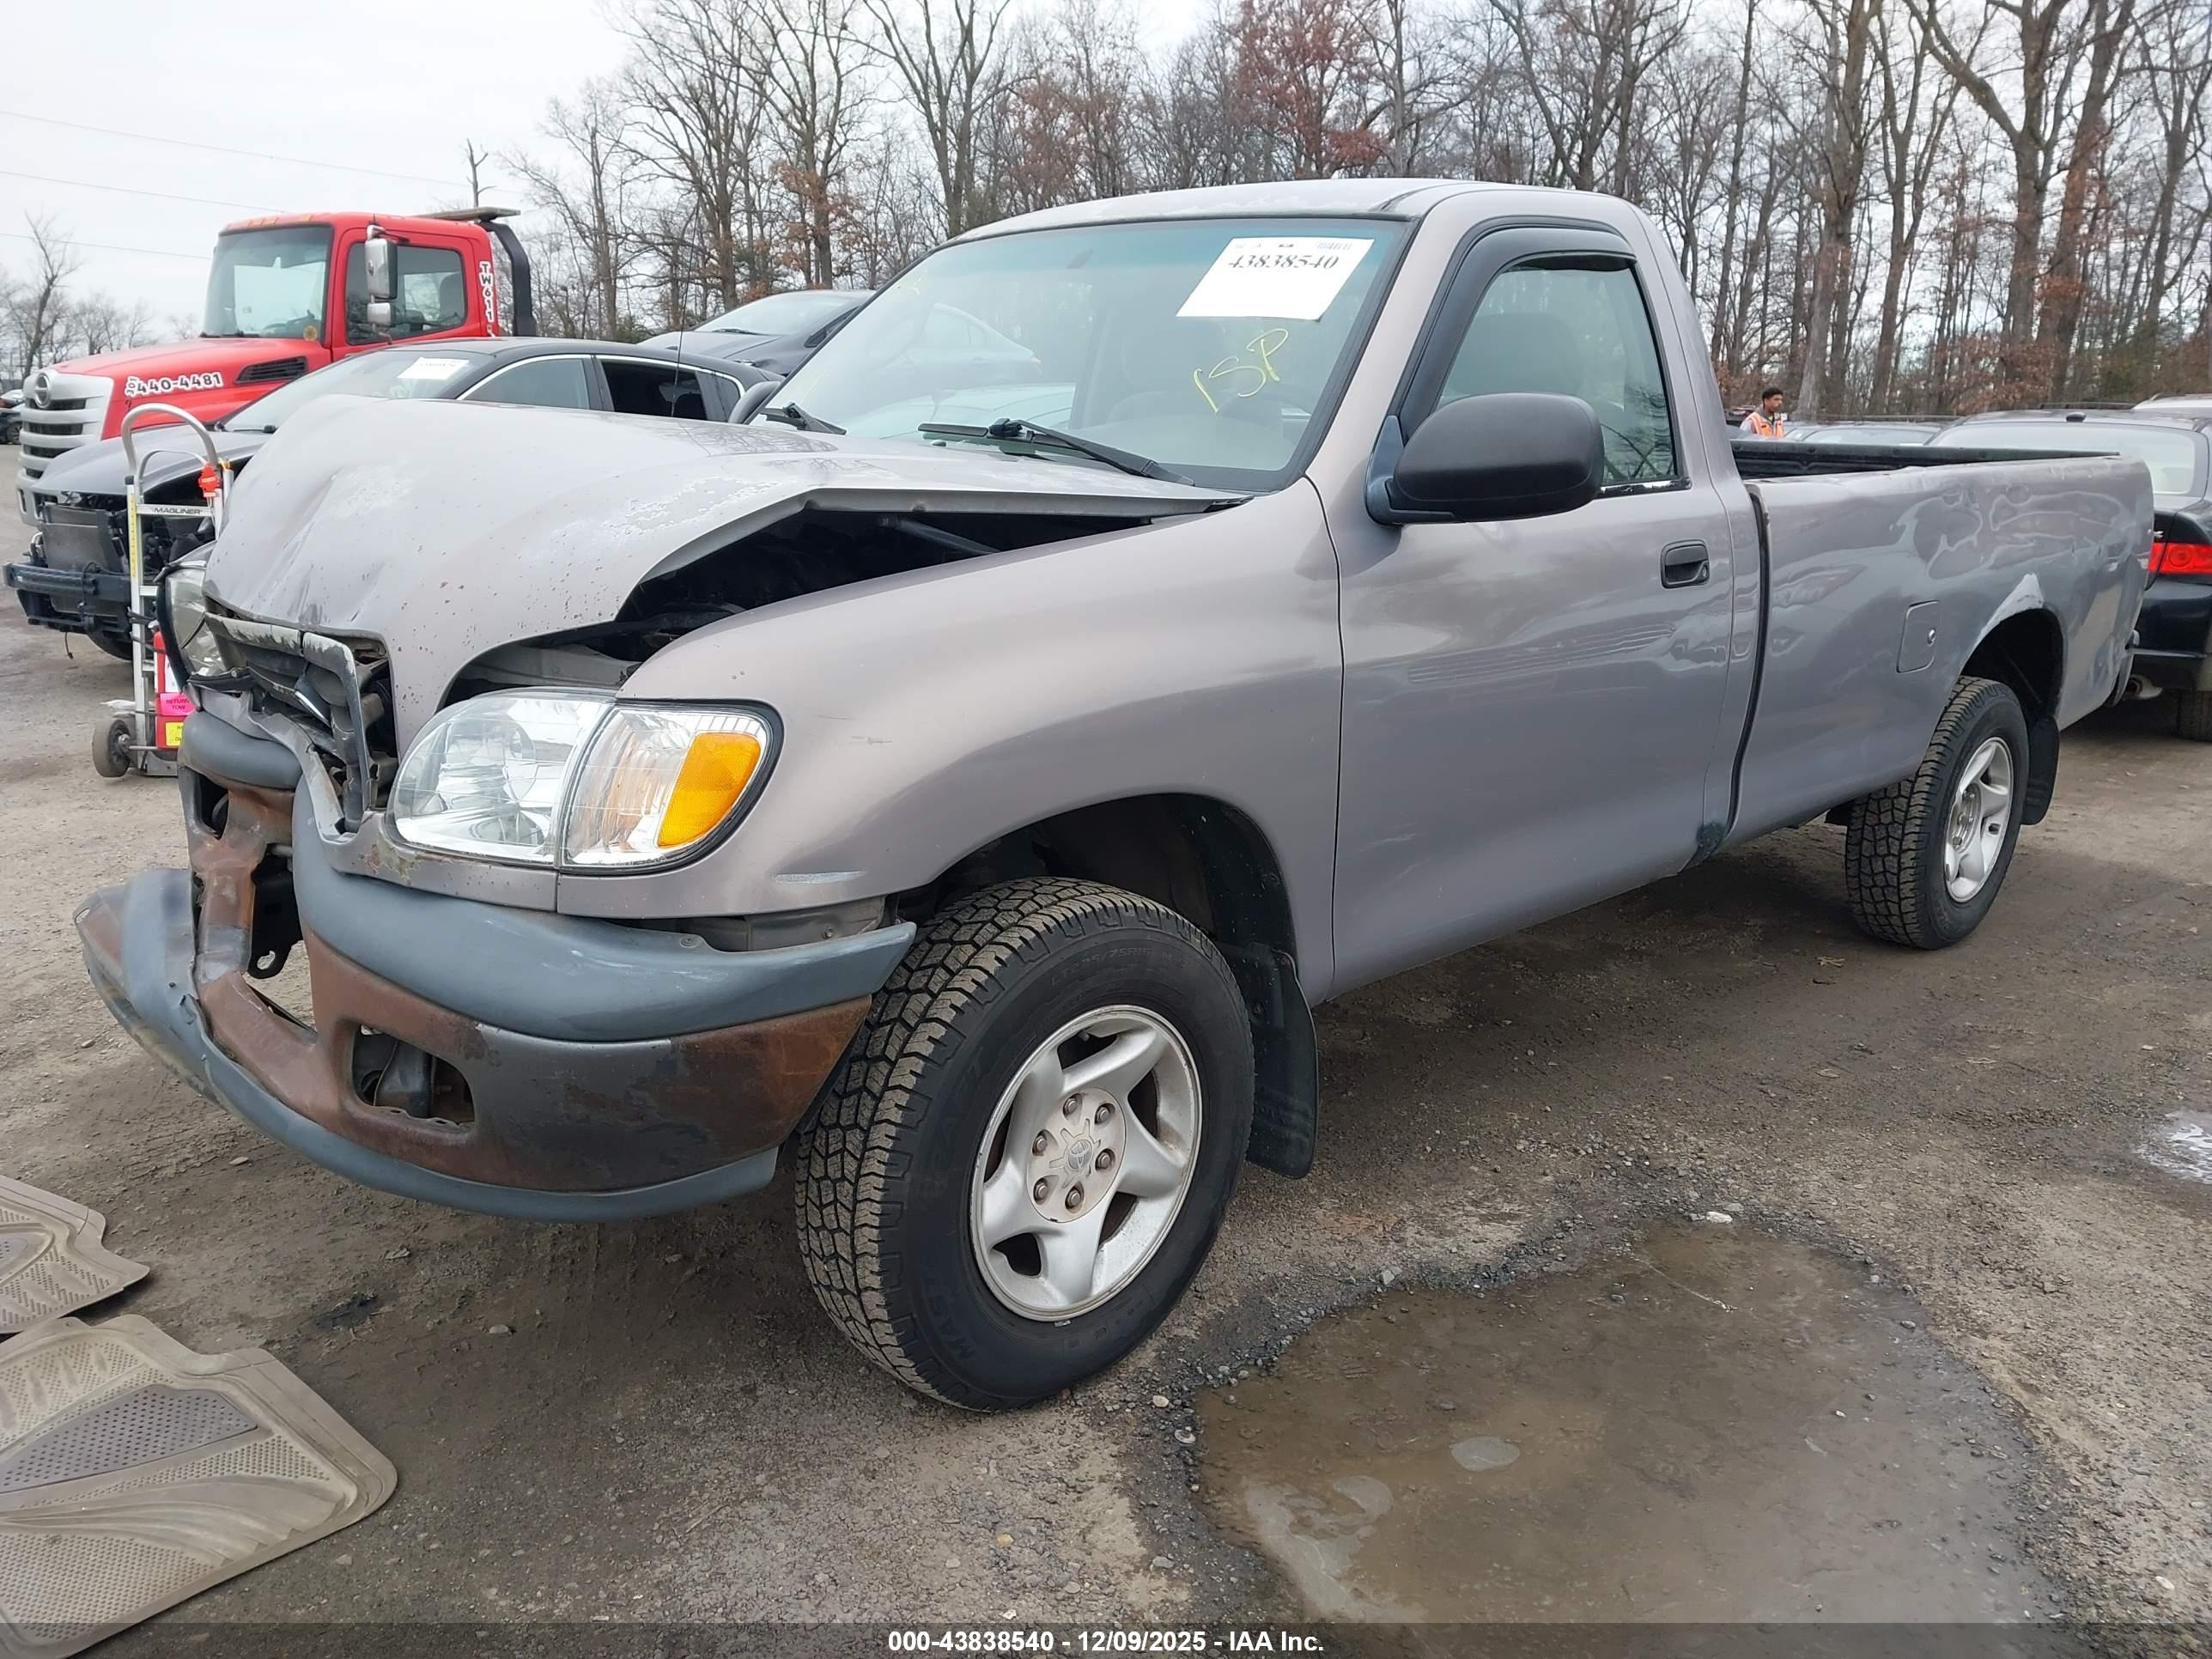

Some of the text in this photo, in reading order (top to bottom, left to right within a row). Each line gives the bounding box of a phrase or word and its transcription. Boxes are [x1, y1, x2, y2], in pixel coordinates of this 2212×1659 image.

[1228, 254, 1340, 269] 43838540
[481, 263, 493, 320] TW611
[137, 373, 222, 393] 440-4481
